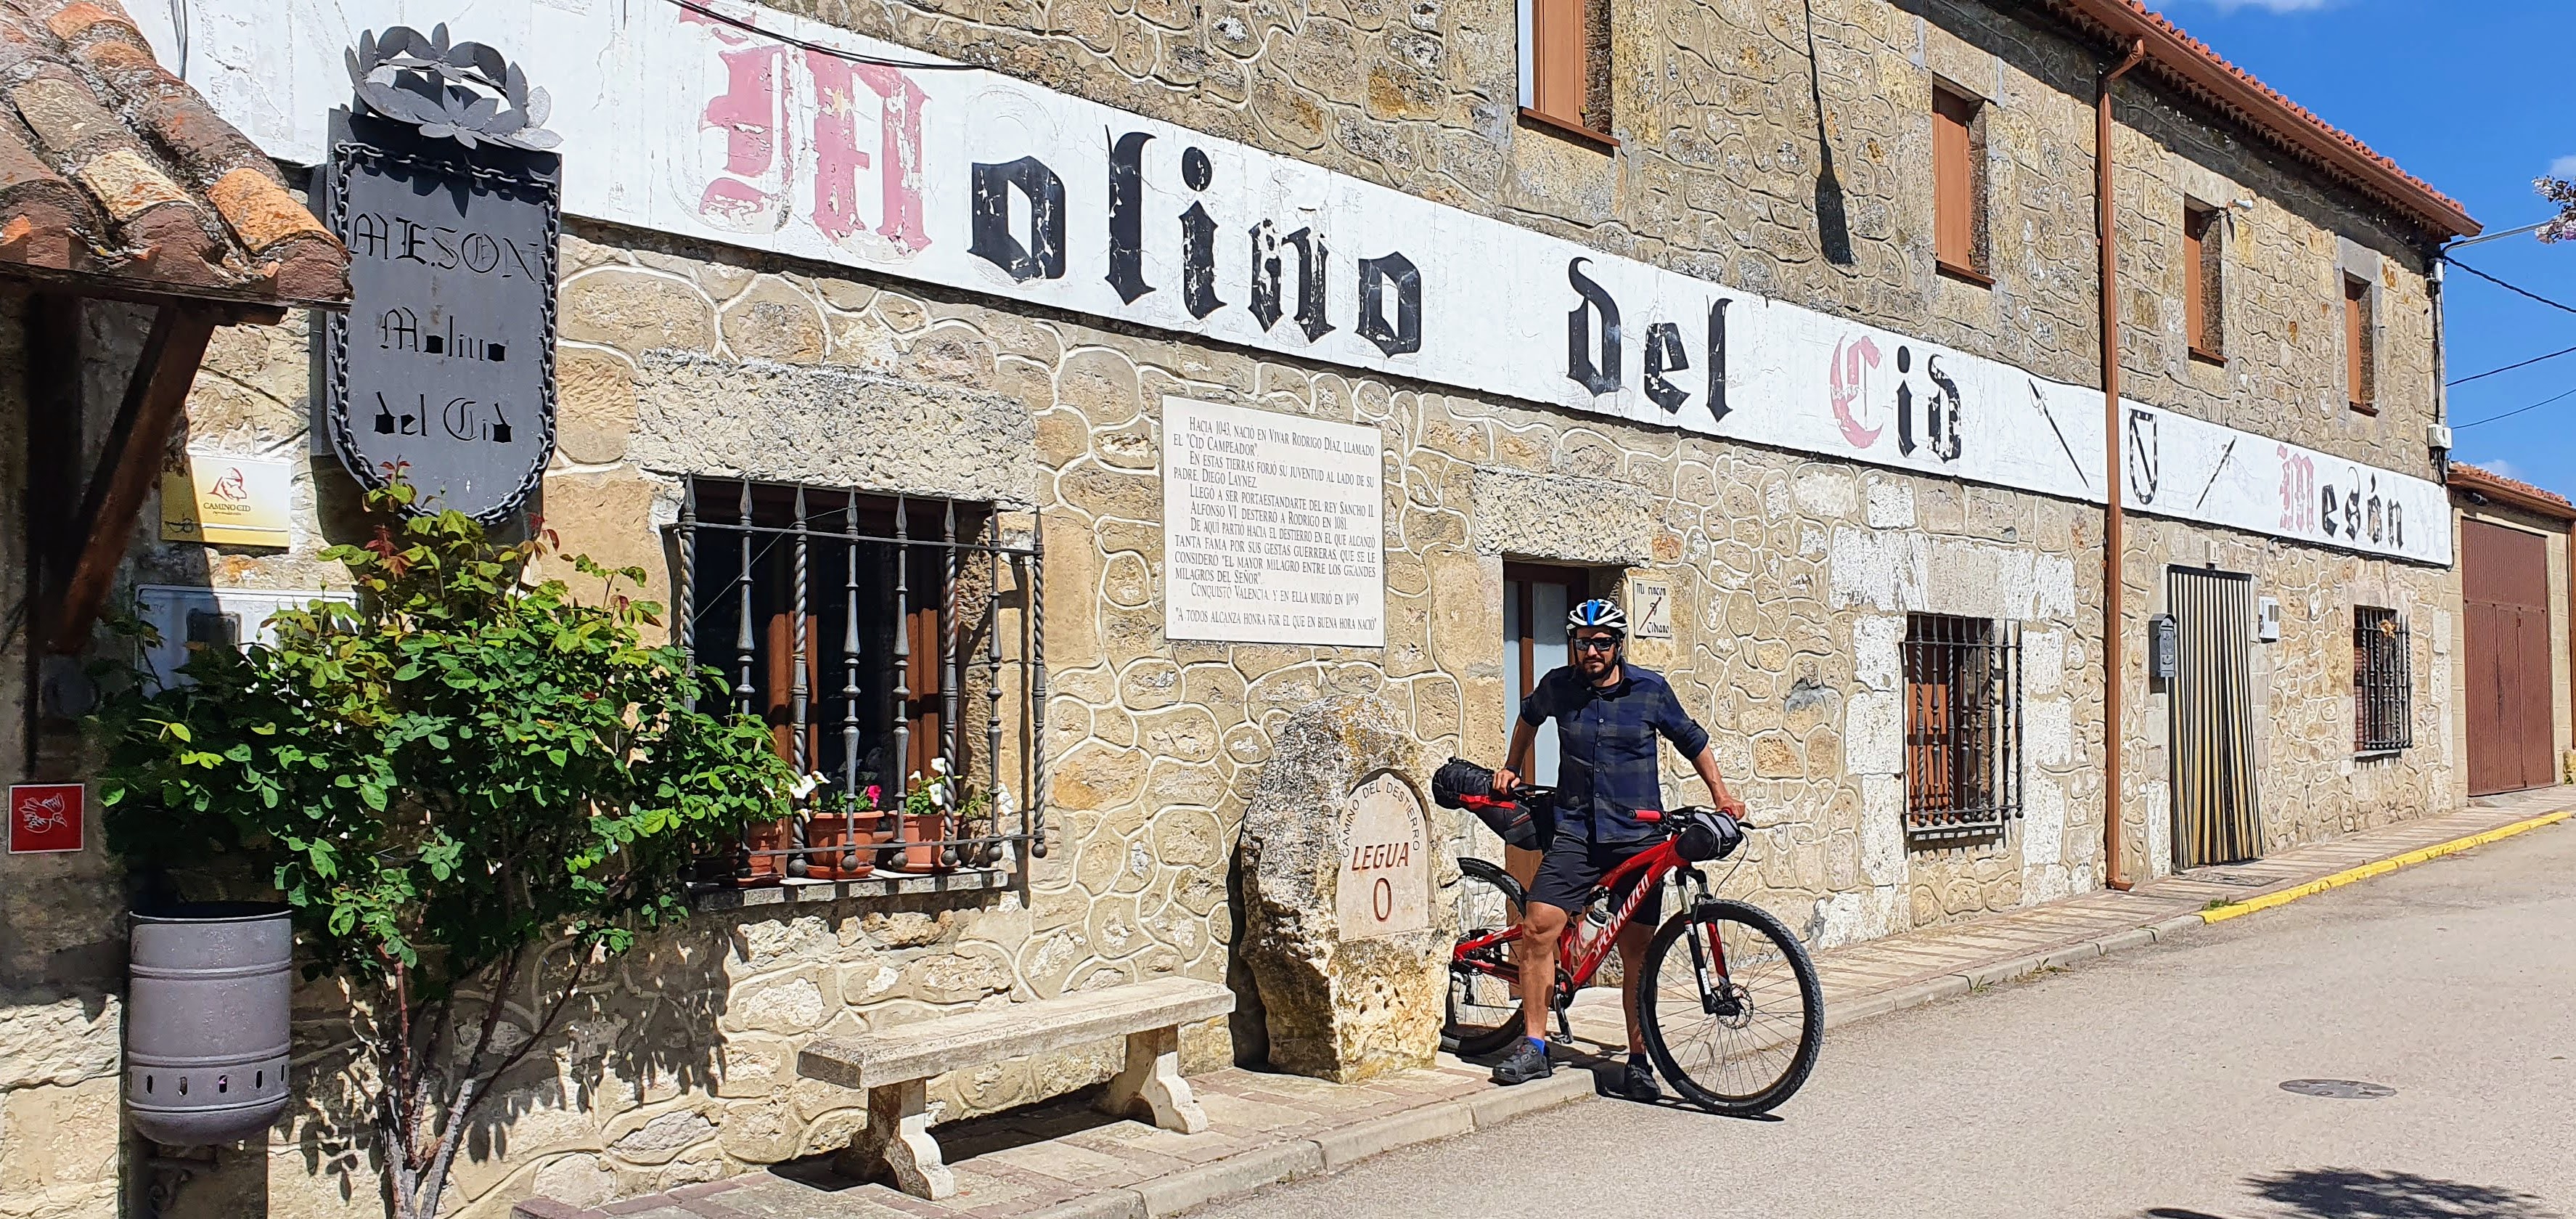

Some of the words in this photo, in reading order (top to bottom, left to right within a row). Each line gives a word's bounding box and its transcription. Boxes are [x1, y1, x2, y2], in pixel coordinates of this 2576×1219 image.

[666, 0, 1421, 359] Molino
[1566, 256, 1733, 423] del
[1830, 330, 1961, 463] Cid
[373, 391, 428, 436] del
[443, 397, 512, 443] Cid
[1174, 433, 1183, 446] EL
[1190, 417, 1212, 433] HACIA
[1234, 425, 1255, 439] NACIÓ
[1258, 429, 1267, 441] EN
[1269, 428, 1289, 444] VIVAR
[1292, 432, 1322, 449] RODRIGO
[1344, 441, 1375, 457] LLAMADO
[1190, 451, 1201, 465] EN
[1203, 454, 1223, 468] ESTAS
[1226, 457, 1254, 472] TIERRAS
[1257, 461, 1277, 476] FORJÓ
[1280, 465, 1288, 476] SU
[1290, 466, 1324, 481] JUVENTUD
[1326, 472, 1335, 482] AL
[1337, 473, 1354, 485] LADO
[1357, 475, 1365, 486] DE
[1367, 476, 1375, 488] SU
[1203, 468, 1226, 484] DIEGO
[1190, 484, 1214, 500] LLEGÓ
[1218, 489, 1223, 501] A
[1226, 490, 1238, 502] SER
[1241, 492, 1307, 510] PORTAESTANDARTE
[1309, 500, 1322, 512] DEL
[1325, 502, 1338, 513] REY
[1340, 502, 1366, 517] SANCHO
[1190, 501, 1224, 518] ALFONSO
[1228, 505, 1237, 519] VI
[1241, 508, 1277, 523] DESTERRÓ
[1280, 513, 1285, 524] A
[1288, 512, 1320, 527] RODRIGO
[1322, 518, 1331, 528] EN
[1190, 518, 1201, 531] DE
[1222, 521, 1244, 536] PARTIÓ
[1247, 525, 1267, 538] HACIA
[1269, 528, 1277, 539] EL
[1280, 529, 1312, 542] DESTIERRO
[1314, 531, 1322, 543] EN
[1325, 533, 1332, 544] EL
[1334, 534, 1346, 547] QUE
[1349, 534, 1375, 549] ALCANZÓ
[1175, 535, 1201, 549] TANTA
[1205, 537, 1227, 551] FAMA
[1230, 540, 1245, 553] POR
[1248, 542, 1262, 553] SUS
[1264, 543, 1291, 556] GESTAS
[1340, 550, 1354, 563] QUE
[1357, 552, 1365, 563] SE
[1367, 553, 1375, 563] LE
[1174, 551, 1219, 566] CONSIDERÓ
[1237, 557, 1264, 569] MAYOR
[1267, 559, 1299, 572] MILAGRO
[1303, 562, 1325, 574] ENTRE
[1329, 564, 1341, 575] LOS
[1344, 565, 1375, 577] GRANDES
[1175, 568, 1214, 582] MILAGROS
[1217, 571, 1231, 583] DEL
[1191, 582, 1232, 600] CONQUISTÓ
[1273, 590, 1278, 601] Y
[1280, 590, 1289, 602] EN
[1292, 591, 1308, 603] ELLA
[1311, 590, 1332, 605] MURIÓ
[1335, 594, 1343, 605] EN
[1186, 610, 1208, 622] TODOS
[1211, 611, 1240, 625] ALCANZA
[1243, 613, 1266, 625] HONRA
[1269, 614, 1280, 626] POR
[1283, 615, 1290, 626] EL
[1293, 616, 1305, 629] QUE
[1307, 616, 1315, 627] EN
[1318, 617, 1338, 629] BUENA
[1340, 618, 1355, 629] HORA
[1343, 799, 1359, 858] CAMINO
[1362, 782, 1381, 799] DEL
[1386, 783, 1420, 852] DESTIERRO
[1352, 842, 1409, 871] LEGUA
[1591, 873, 1650, 961] SPECIALIZED
